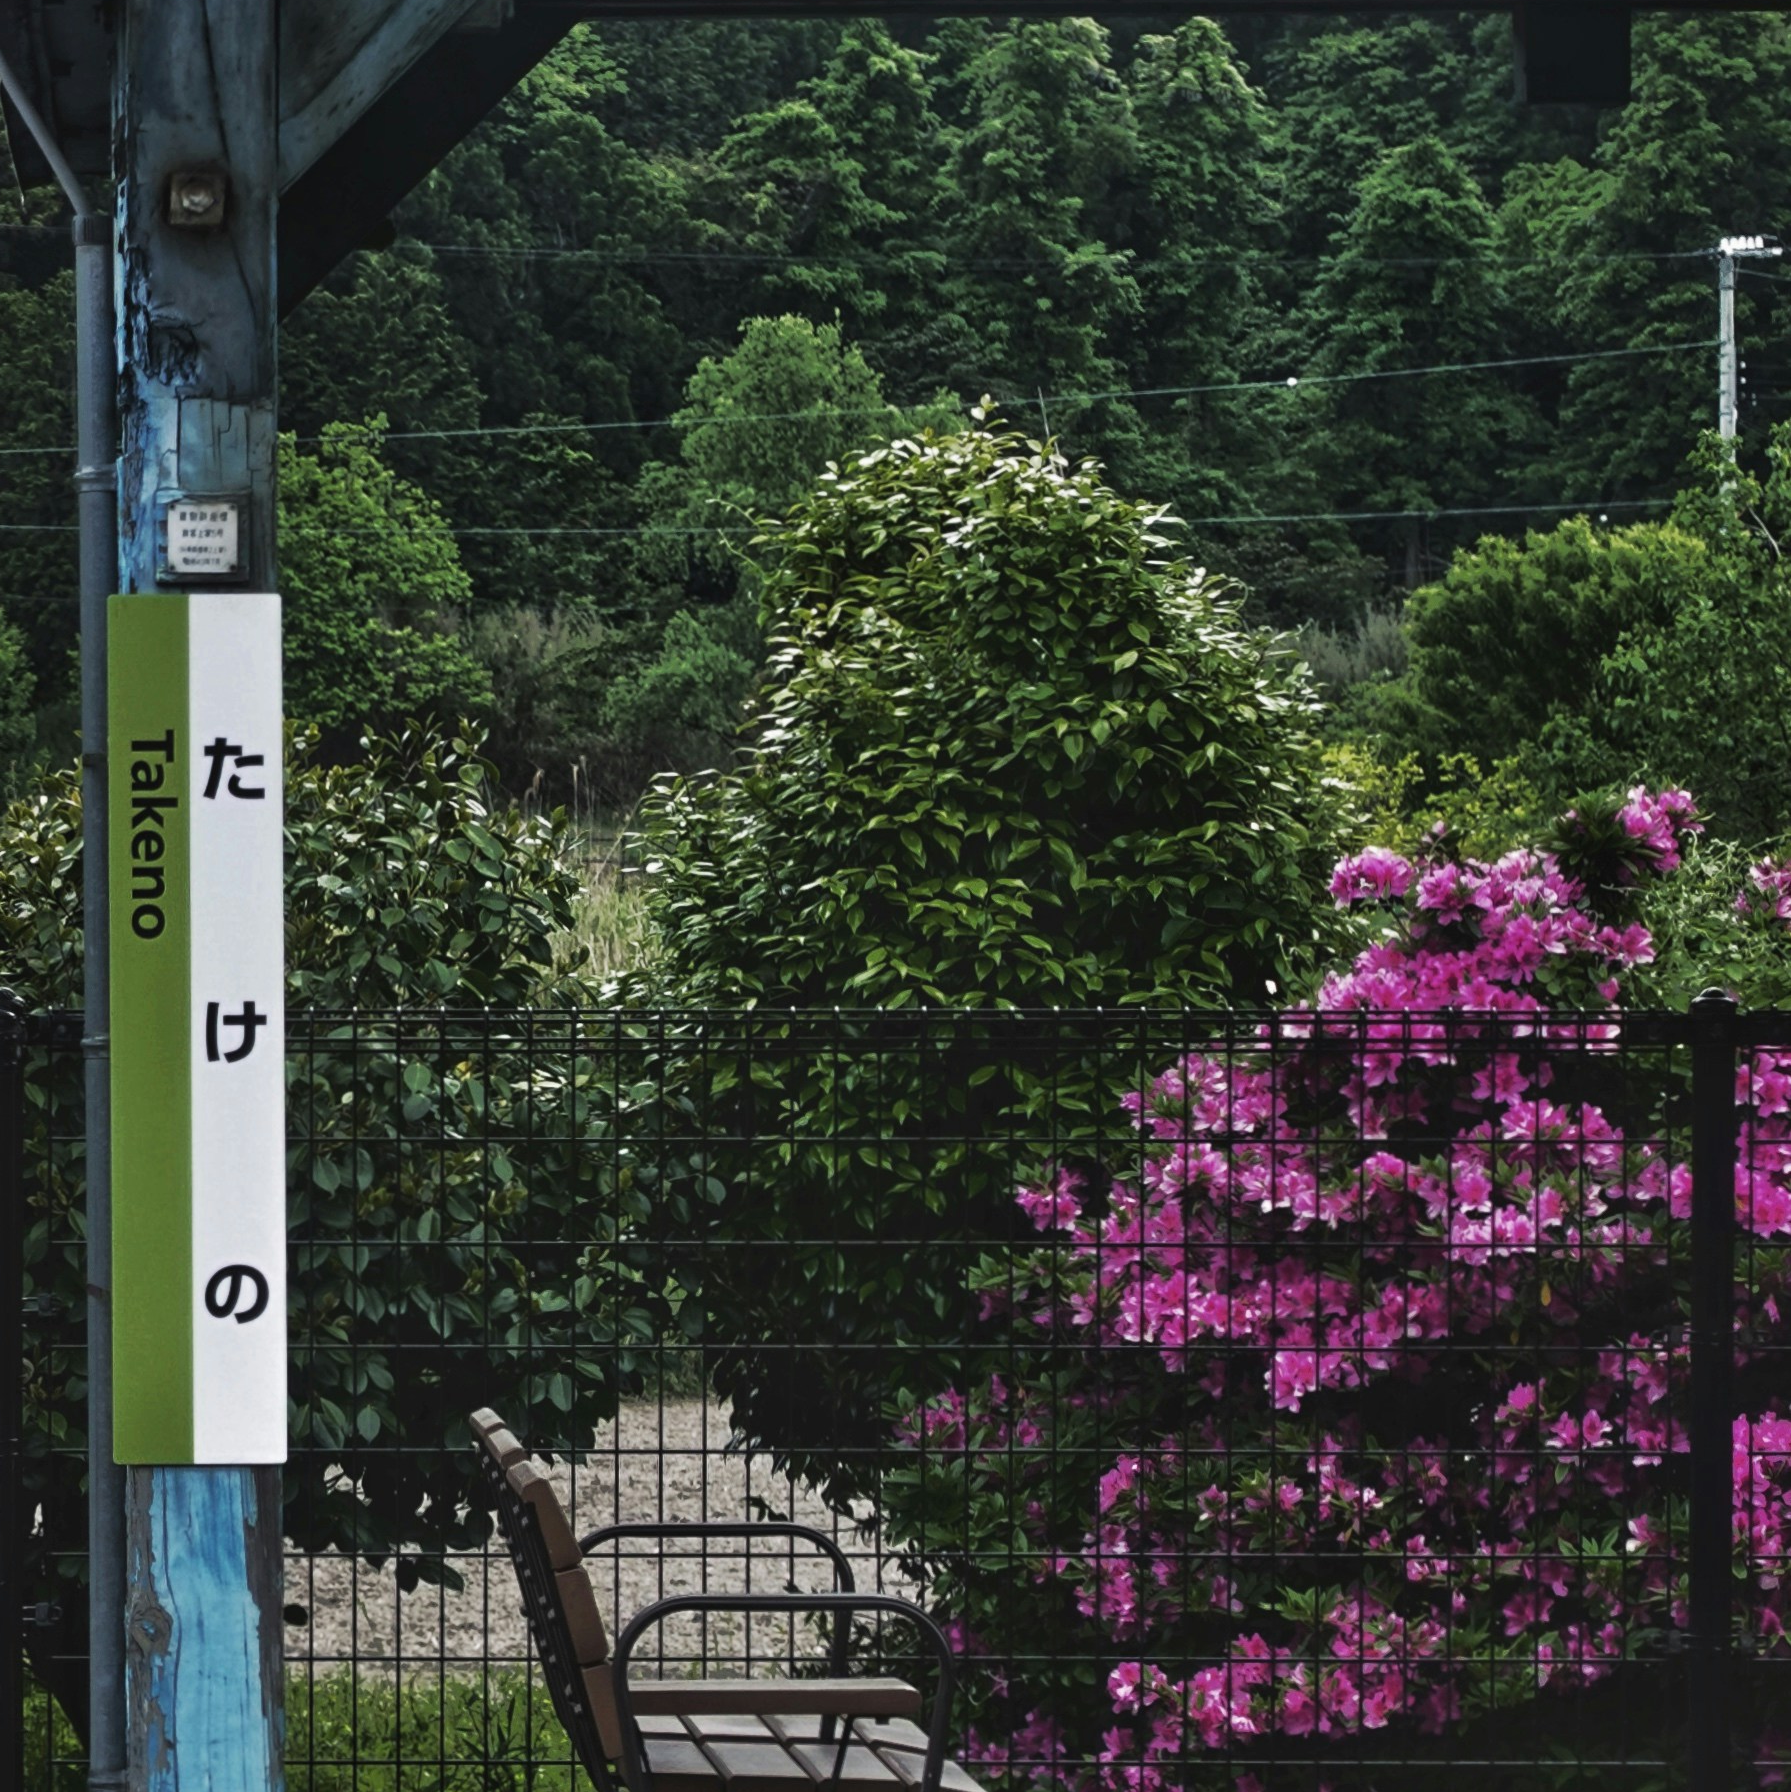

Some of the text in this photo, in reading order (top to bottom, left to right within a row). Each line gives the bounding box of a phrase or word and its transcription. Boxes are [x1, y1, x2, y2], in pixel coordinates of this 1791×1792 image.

[130, 729, 179, 940] Takeno
[203, 737, 270, 1325] たけの
